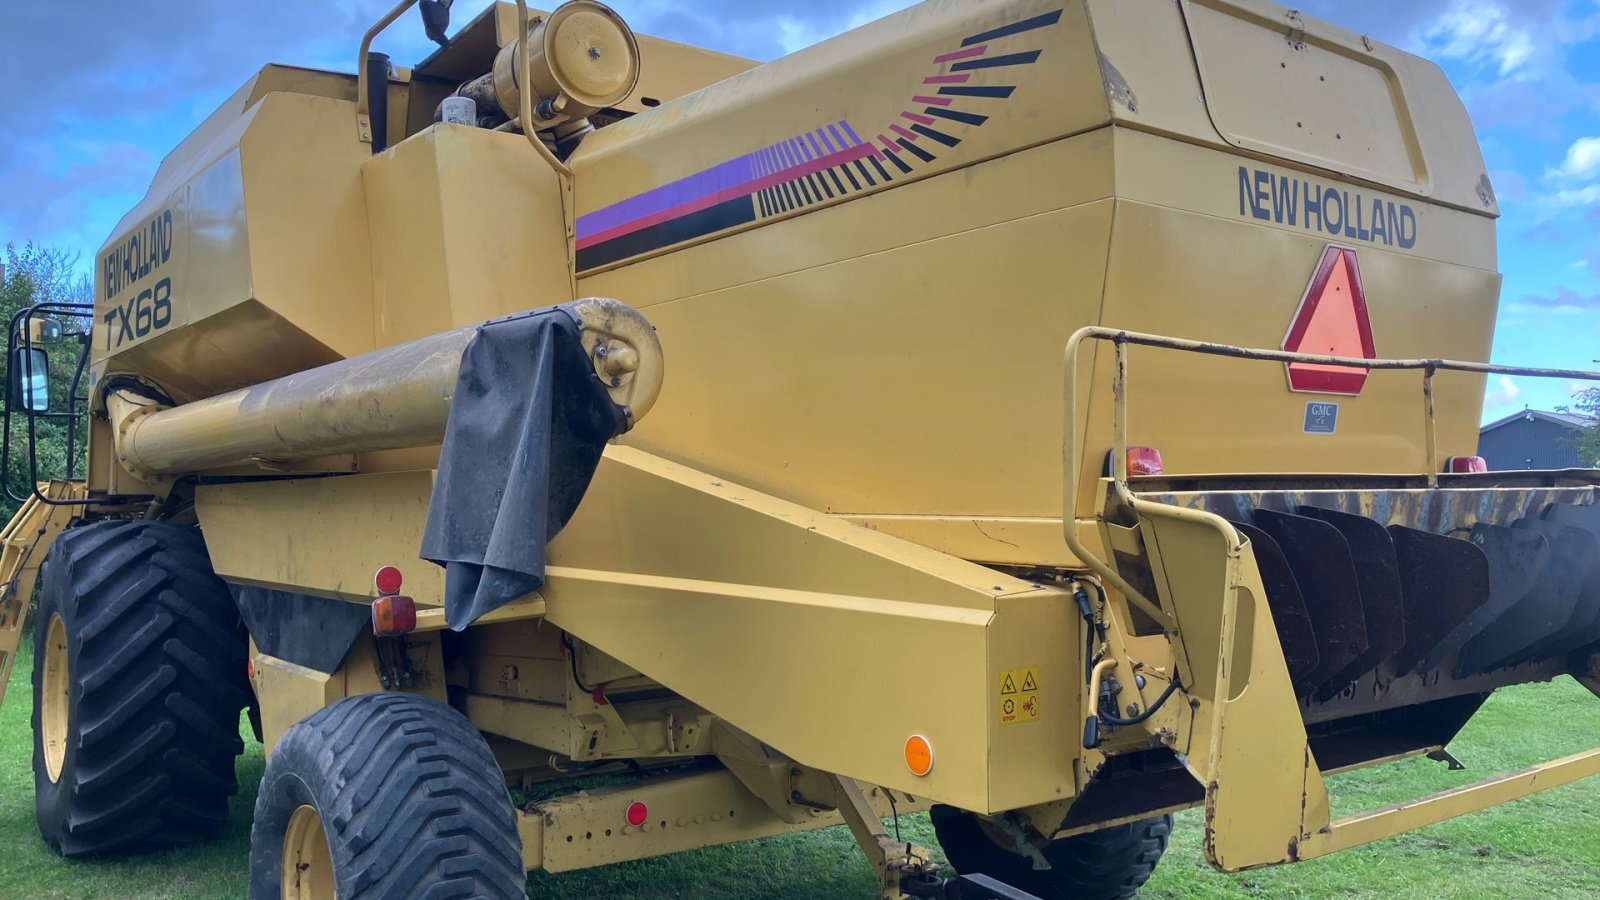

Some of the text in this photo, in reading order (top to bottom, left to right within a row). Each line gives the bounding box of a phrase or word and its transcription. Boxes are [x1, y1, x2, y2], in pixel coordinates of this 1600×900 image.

[1238, 165, 1417, 249] NEW HOLLAND
[103, 209, 173, 303] NEW HOLLAND
[103, 276, 172, 352] TX68
[1311, 404, 1333, 416] GMC
